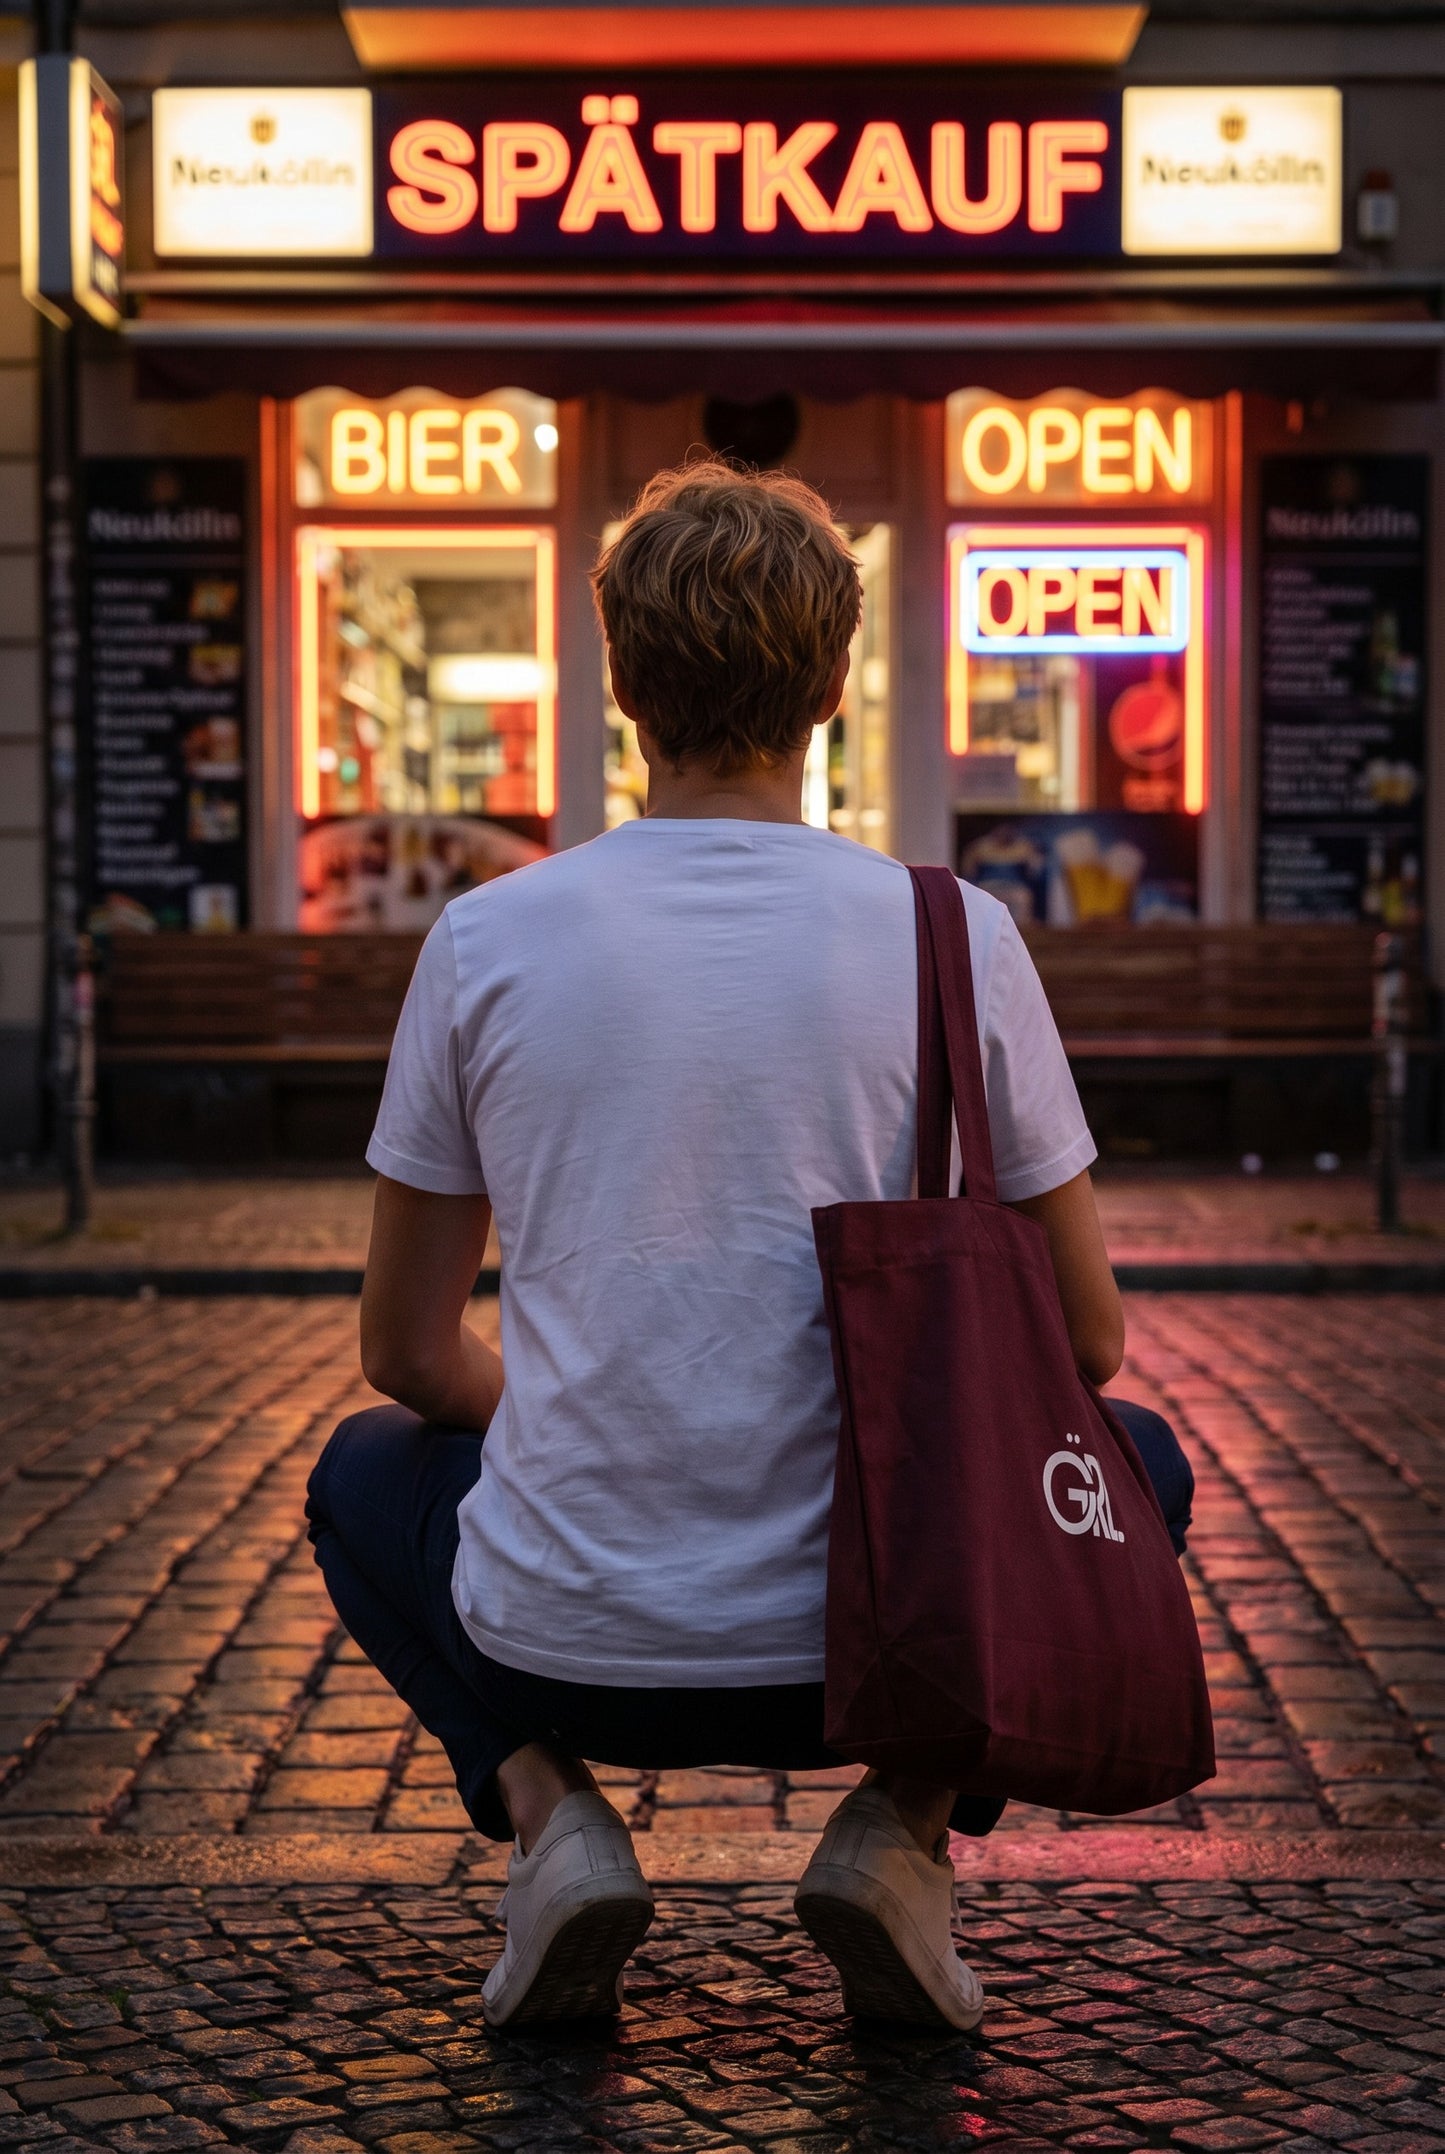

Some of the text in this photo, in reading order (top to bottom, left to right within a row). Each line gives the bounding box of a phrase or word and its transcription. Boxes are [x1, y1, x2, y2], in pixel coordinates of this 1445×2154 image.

[387, 95, 1109, 234] SPÄTKAUF
[331, 408, 523, 495] BIER
[961, 406, 1193, 495] OPEN
[977, 564, 1174, 638] OPEN
